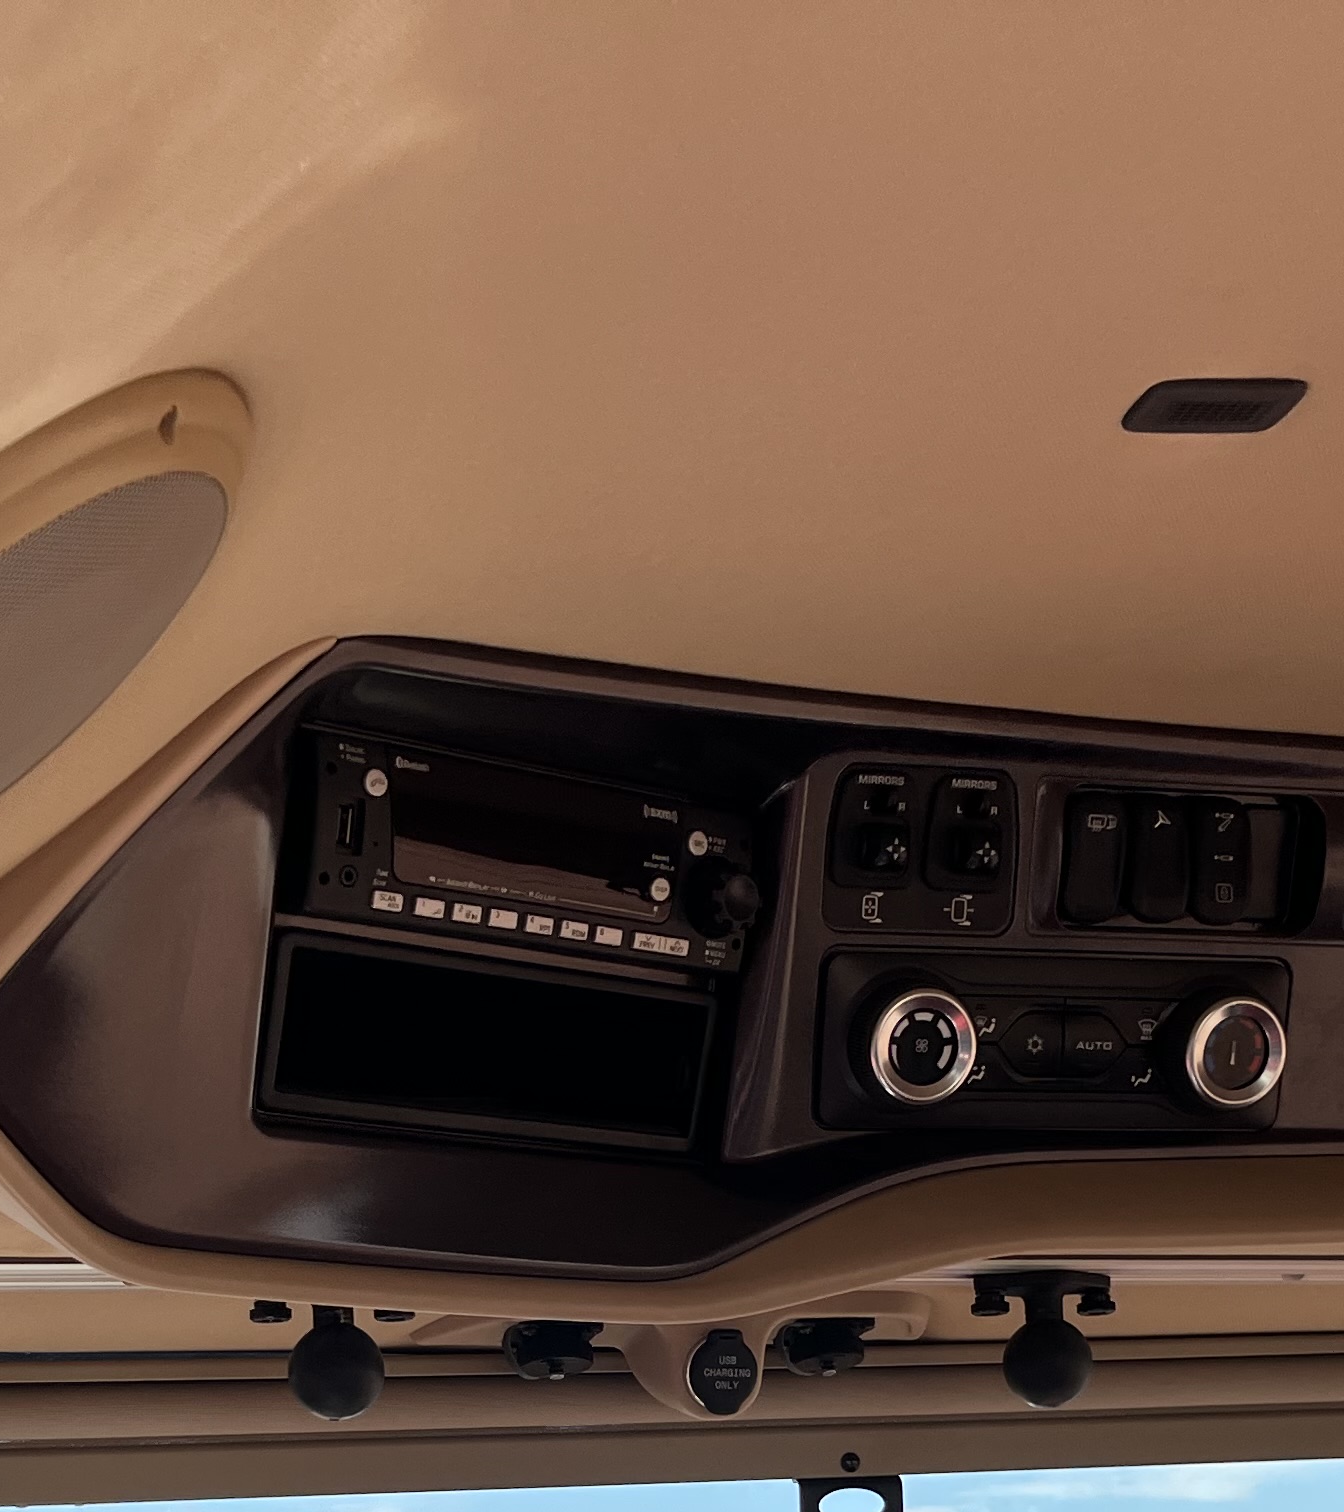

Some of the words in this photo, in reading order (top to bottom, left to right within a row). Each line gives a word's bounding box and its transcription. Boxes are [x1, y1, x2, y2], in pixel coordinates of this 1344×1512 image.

[857, 774, 905, 787] MIRRORS
[951, 778, 998, 791] MIRRORS
[863, 800, 871, 810] L
[956, 804, 963, 814] L
[378, 894, 397, 903] SCAN
[1075, 1041, 1113, 1051] AUTO
[718, 1355, 737, 1365] USB
[703, 1367, 751, 1378] CHARGING
[714, 1380, 739, 1390] ONLY
